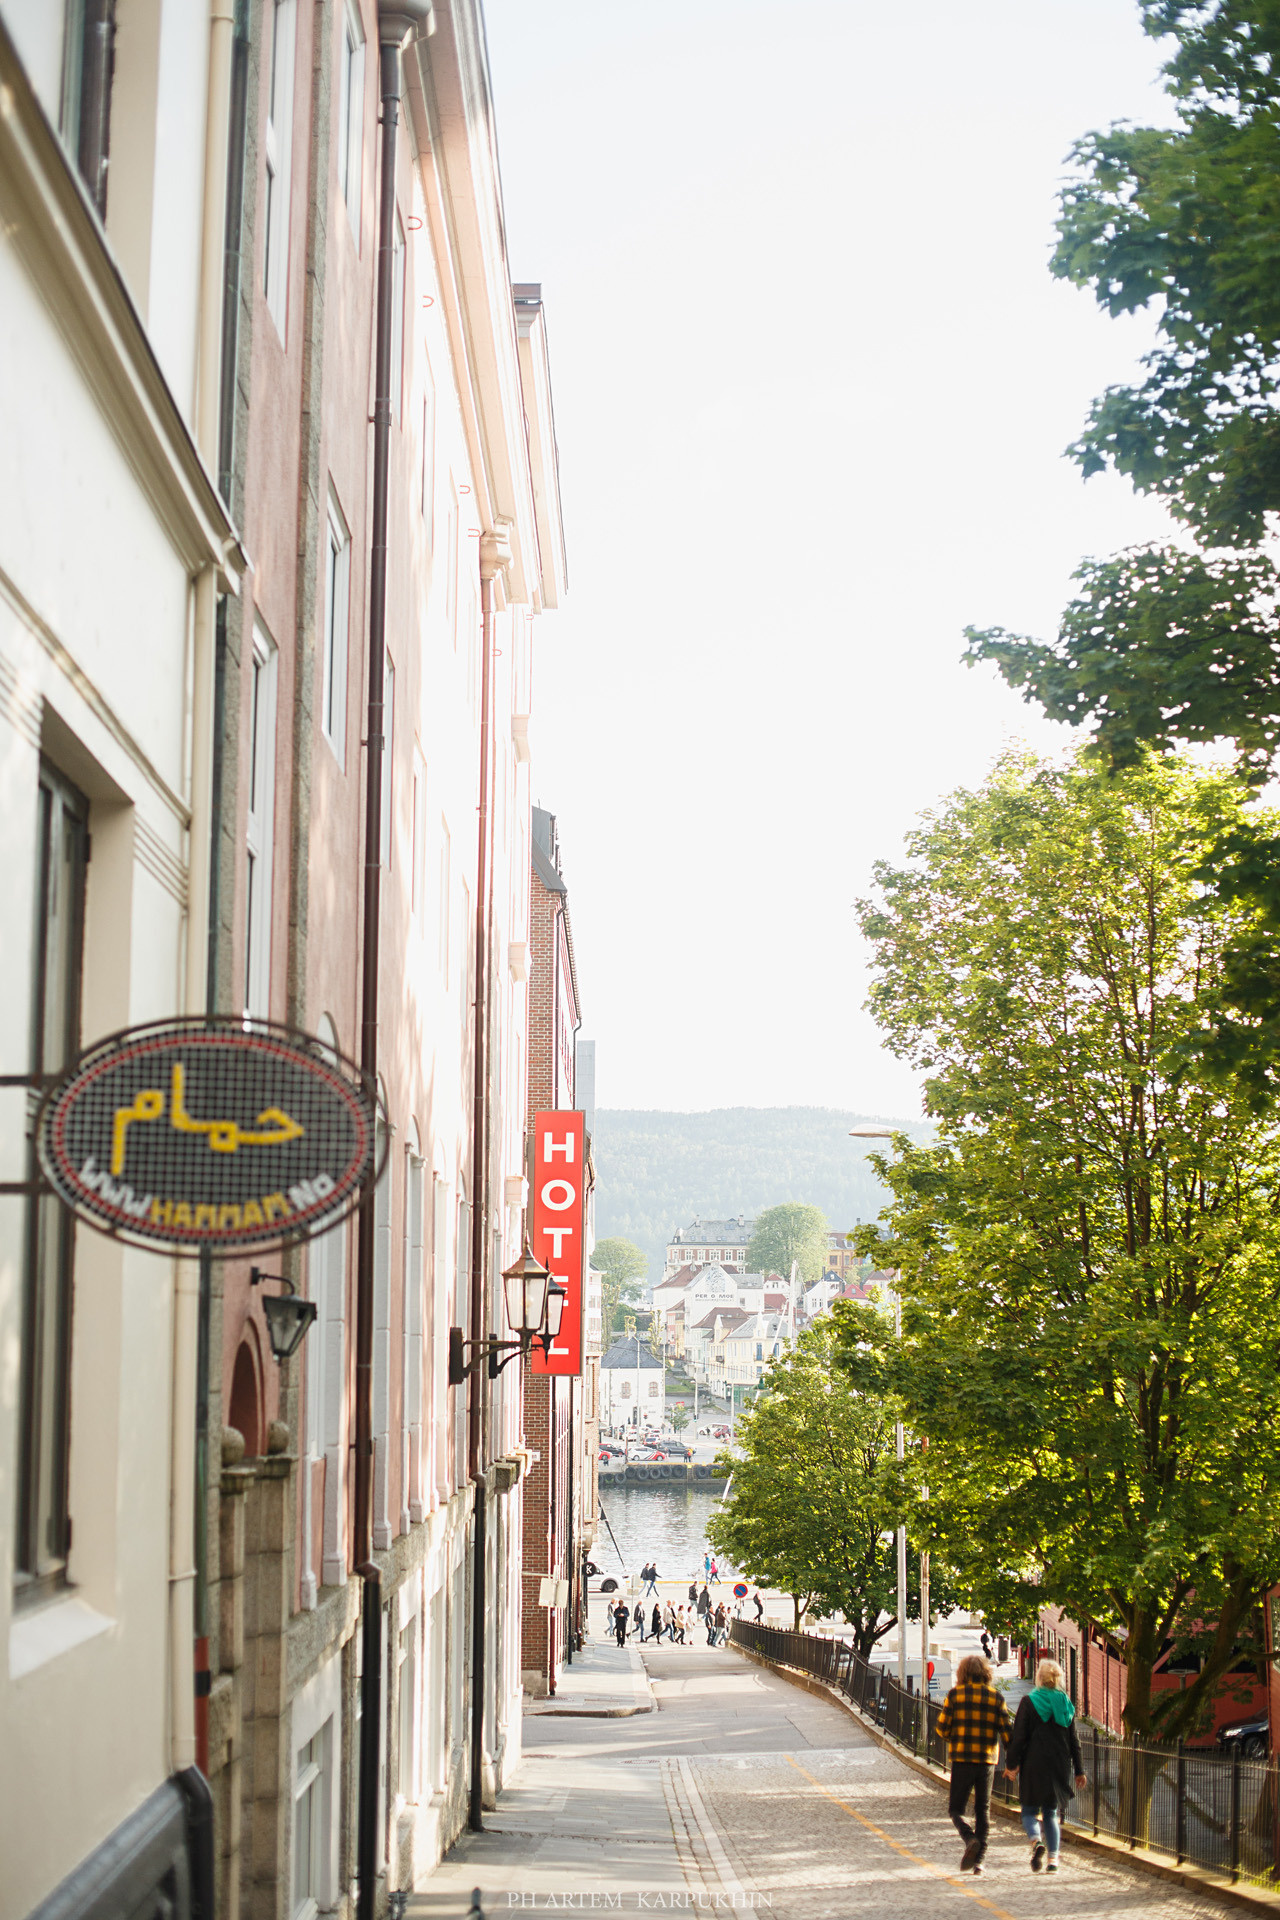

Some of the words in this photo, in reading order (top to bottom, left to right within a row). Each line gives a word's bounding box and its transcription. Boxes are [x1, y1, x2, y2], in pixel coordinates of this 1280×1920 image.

[110, 1062, 305, 1177] حمام
[541, 1132, 576, 1355] HOTL
[585, 1564, 593, 1575] K
